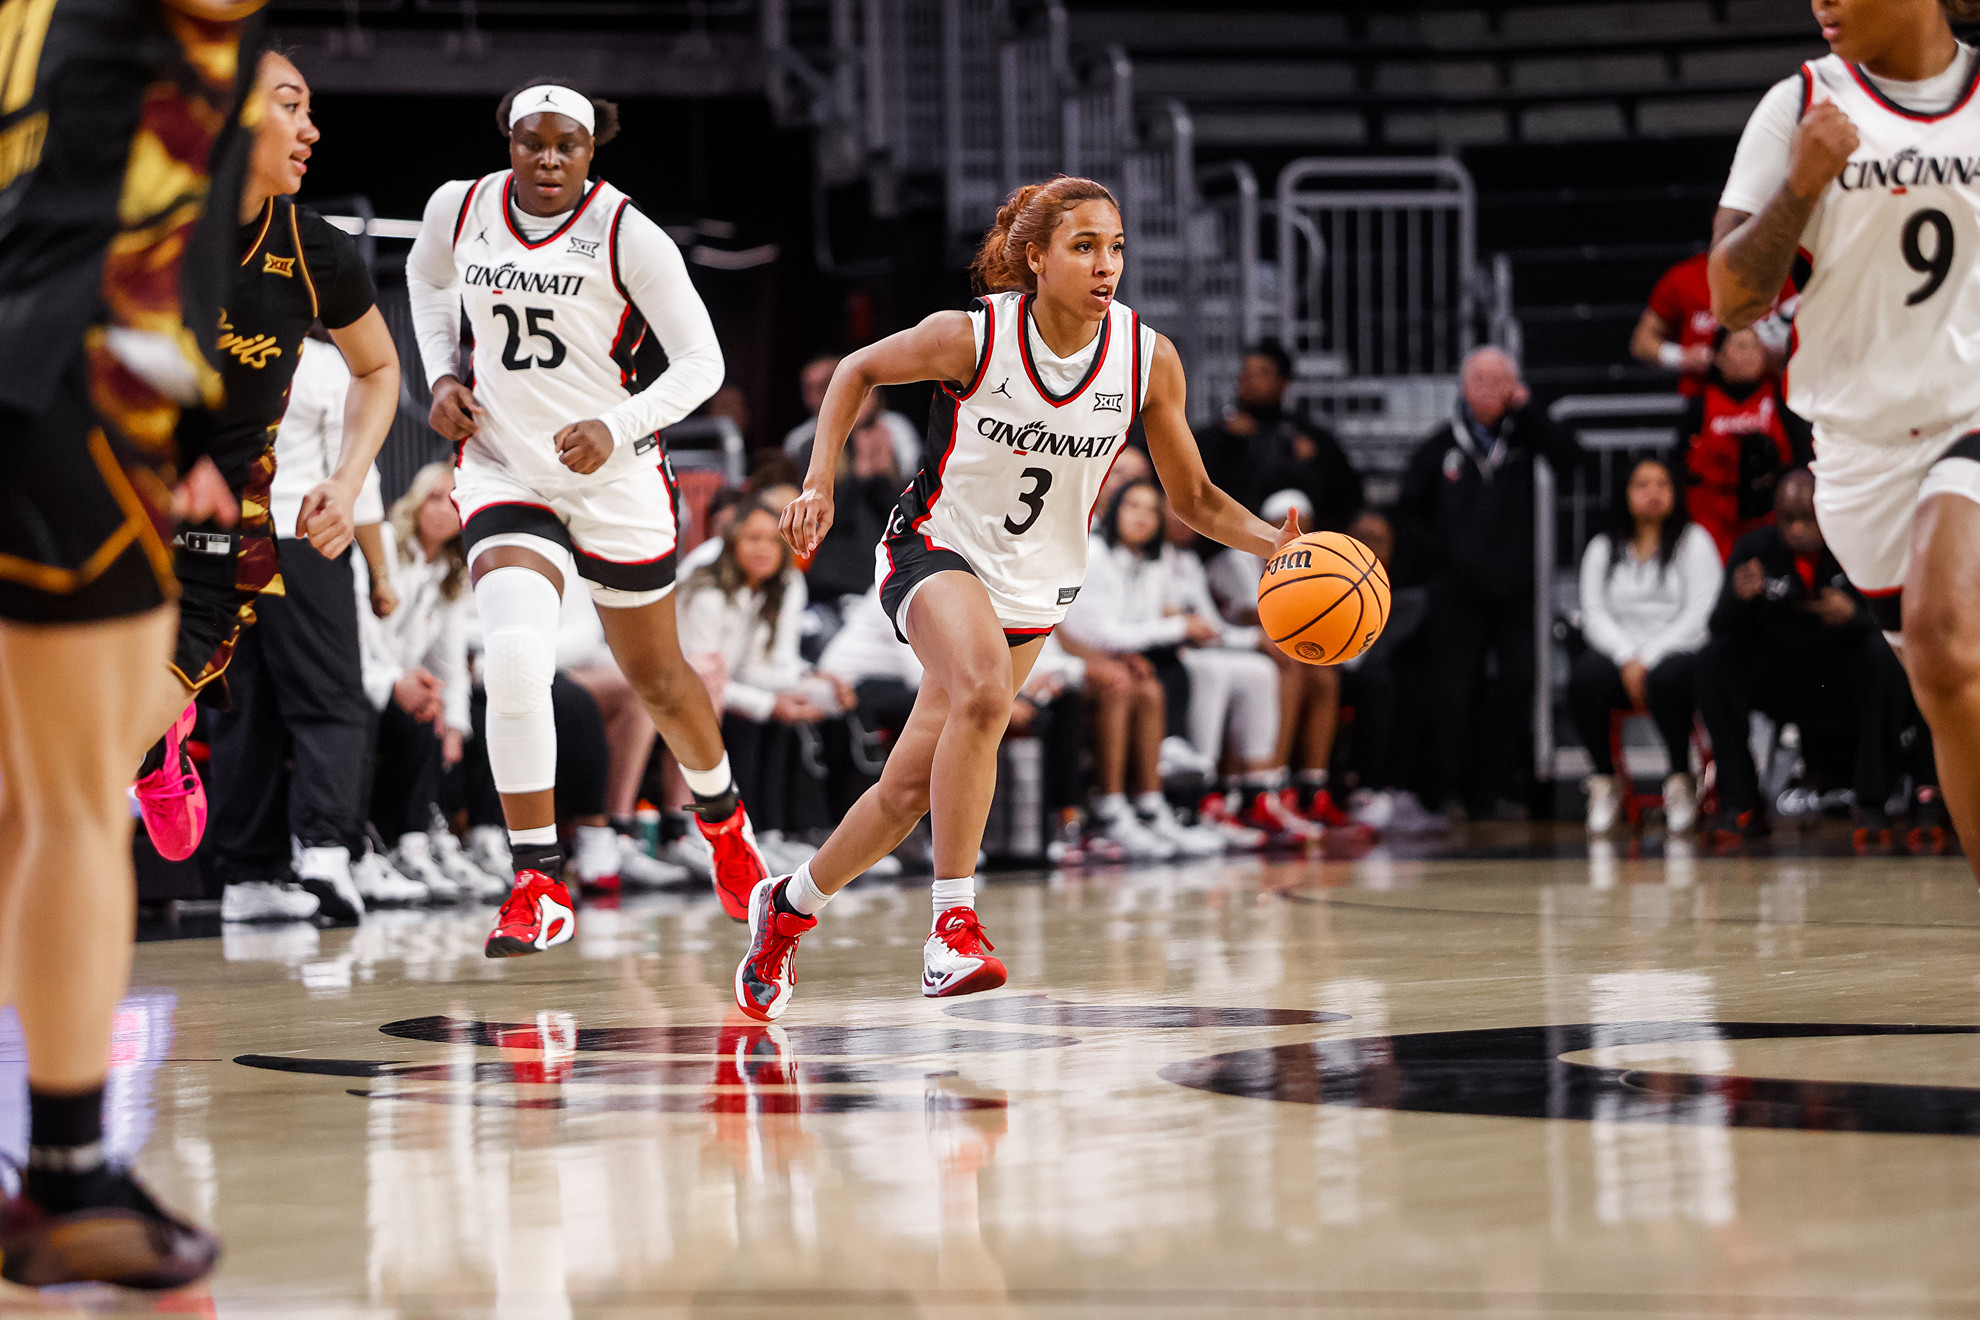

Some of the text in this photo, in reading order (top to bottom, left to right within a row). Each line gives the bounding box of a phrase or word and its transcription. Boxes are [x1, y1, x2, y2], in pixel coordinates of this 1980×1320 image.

[465, 262, 584, 296] CINCINNATI
[1901, 207, 1955, 307] 9
[492, 304, 567, 371] 25
[977, 417, 1118, 458] CINCINNATI
[1003, 467, 1053, 535] 3
